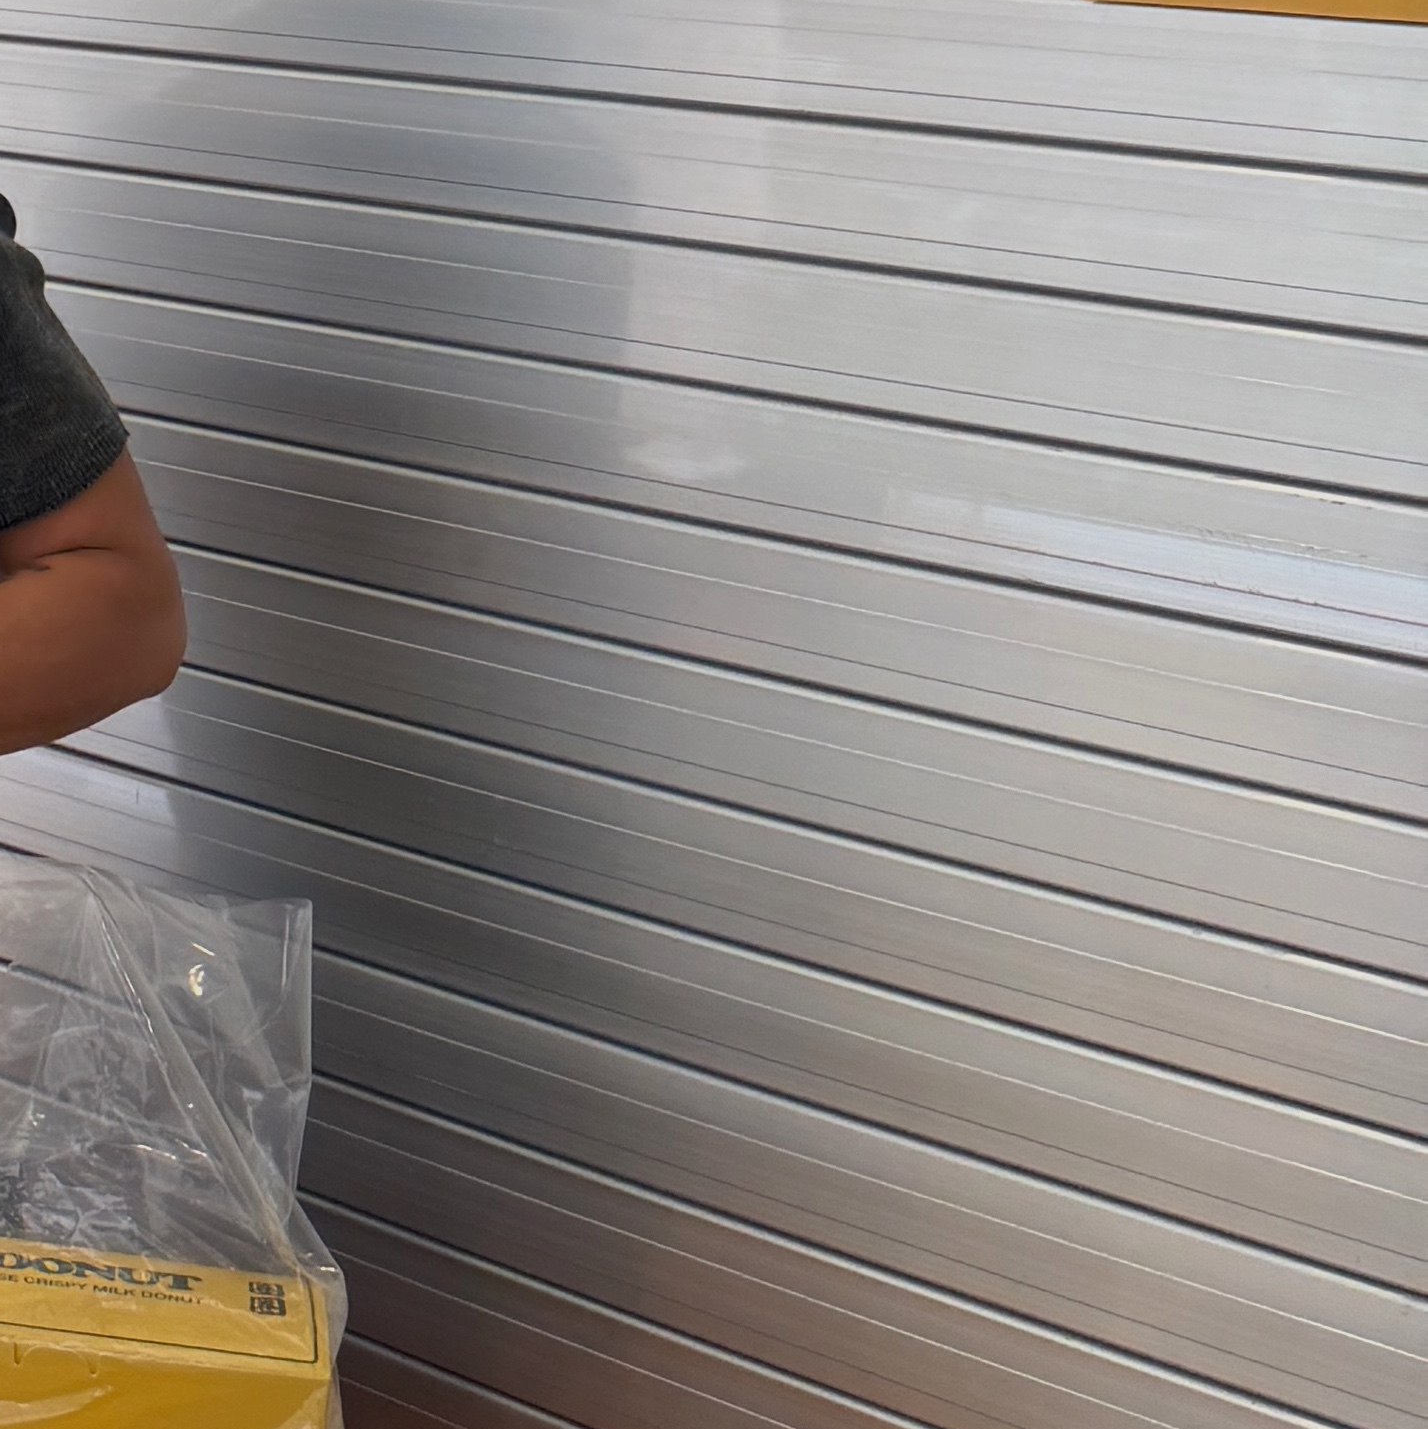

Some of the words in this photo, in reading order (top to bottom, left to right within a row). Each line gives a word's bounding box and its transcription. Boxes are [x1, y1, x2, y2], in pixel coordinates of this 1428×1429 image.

[23, 1275, 89, 1292] CRISPY
[93, 1283, 137, 1299] MILK
[141, 1289, 205, 1306] DONUT
